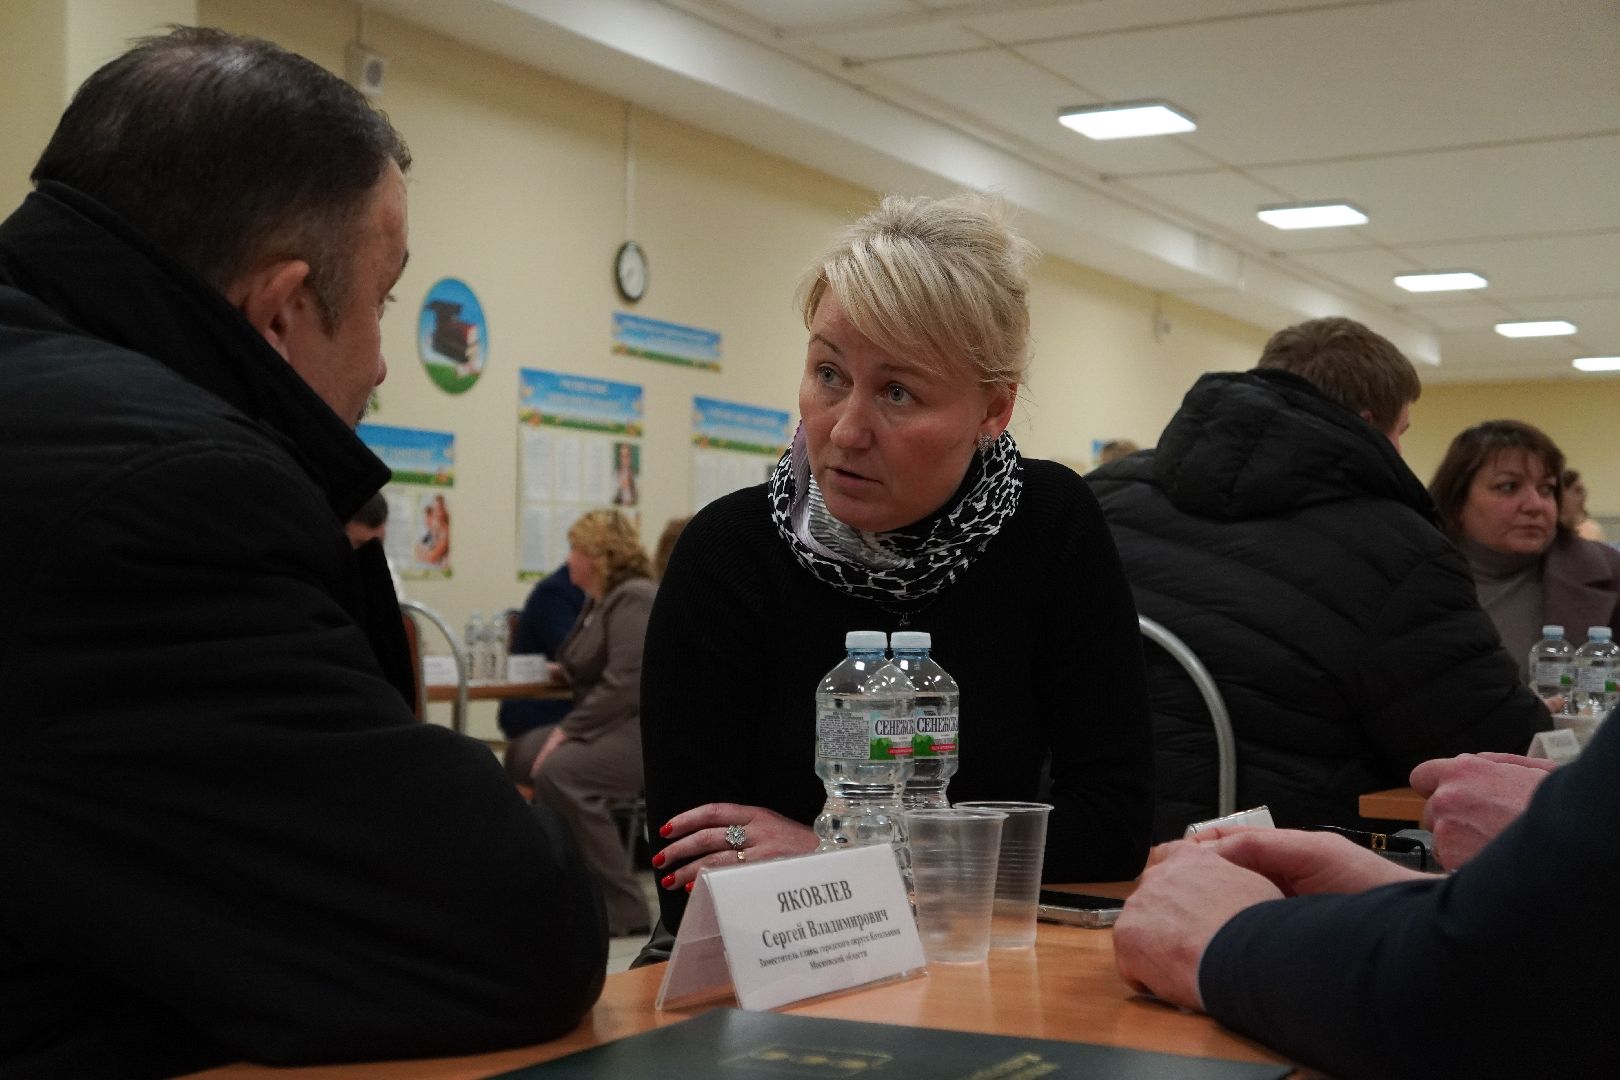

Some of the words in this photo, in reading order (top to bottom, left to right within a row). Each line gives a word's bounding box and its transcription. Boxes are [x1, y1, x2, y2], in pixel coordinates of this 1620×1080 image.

[777, 880, 852, 913] ЯКОВЛЕВ
[762, 922, 807, 949] Сергей
[806, 909, 889, 938] Владимирович
[759, 953, 800, 968] Заместитель
